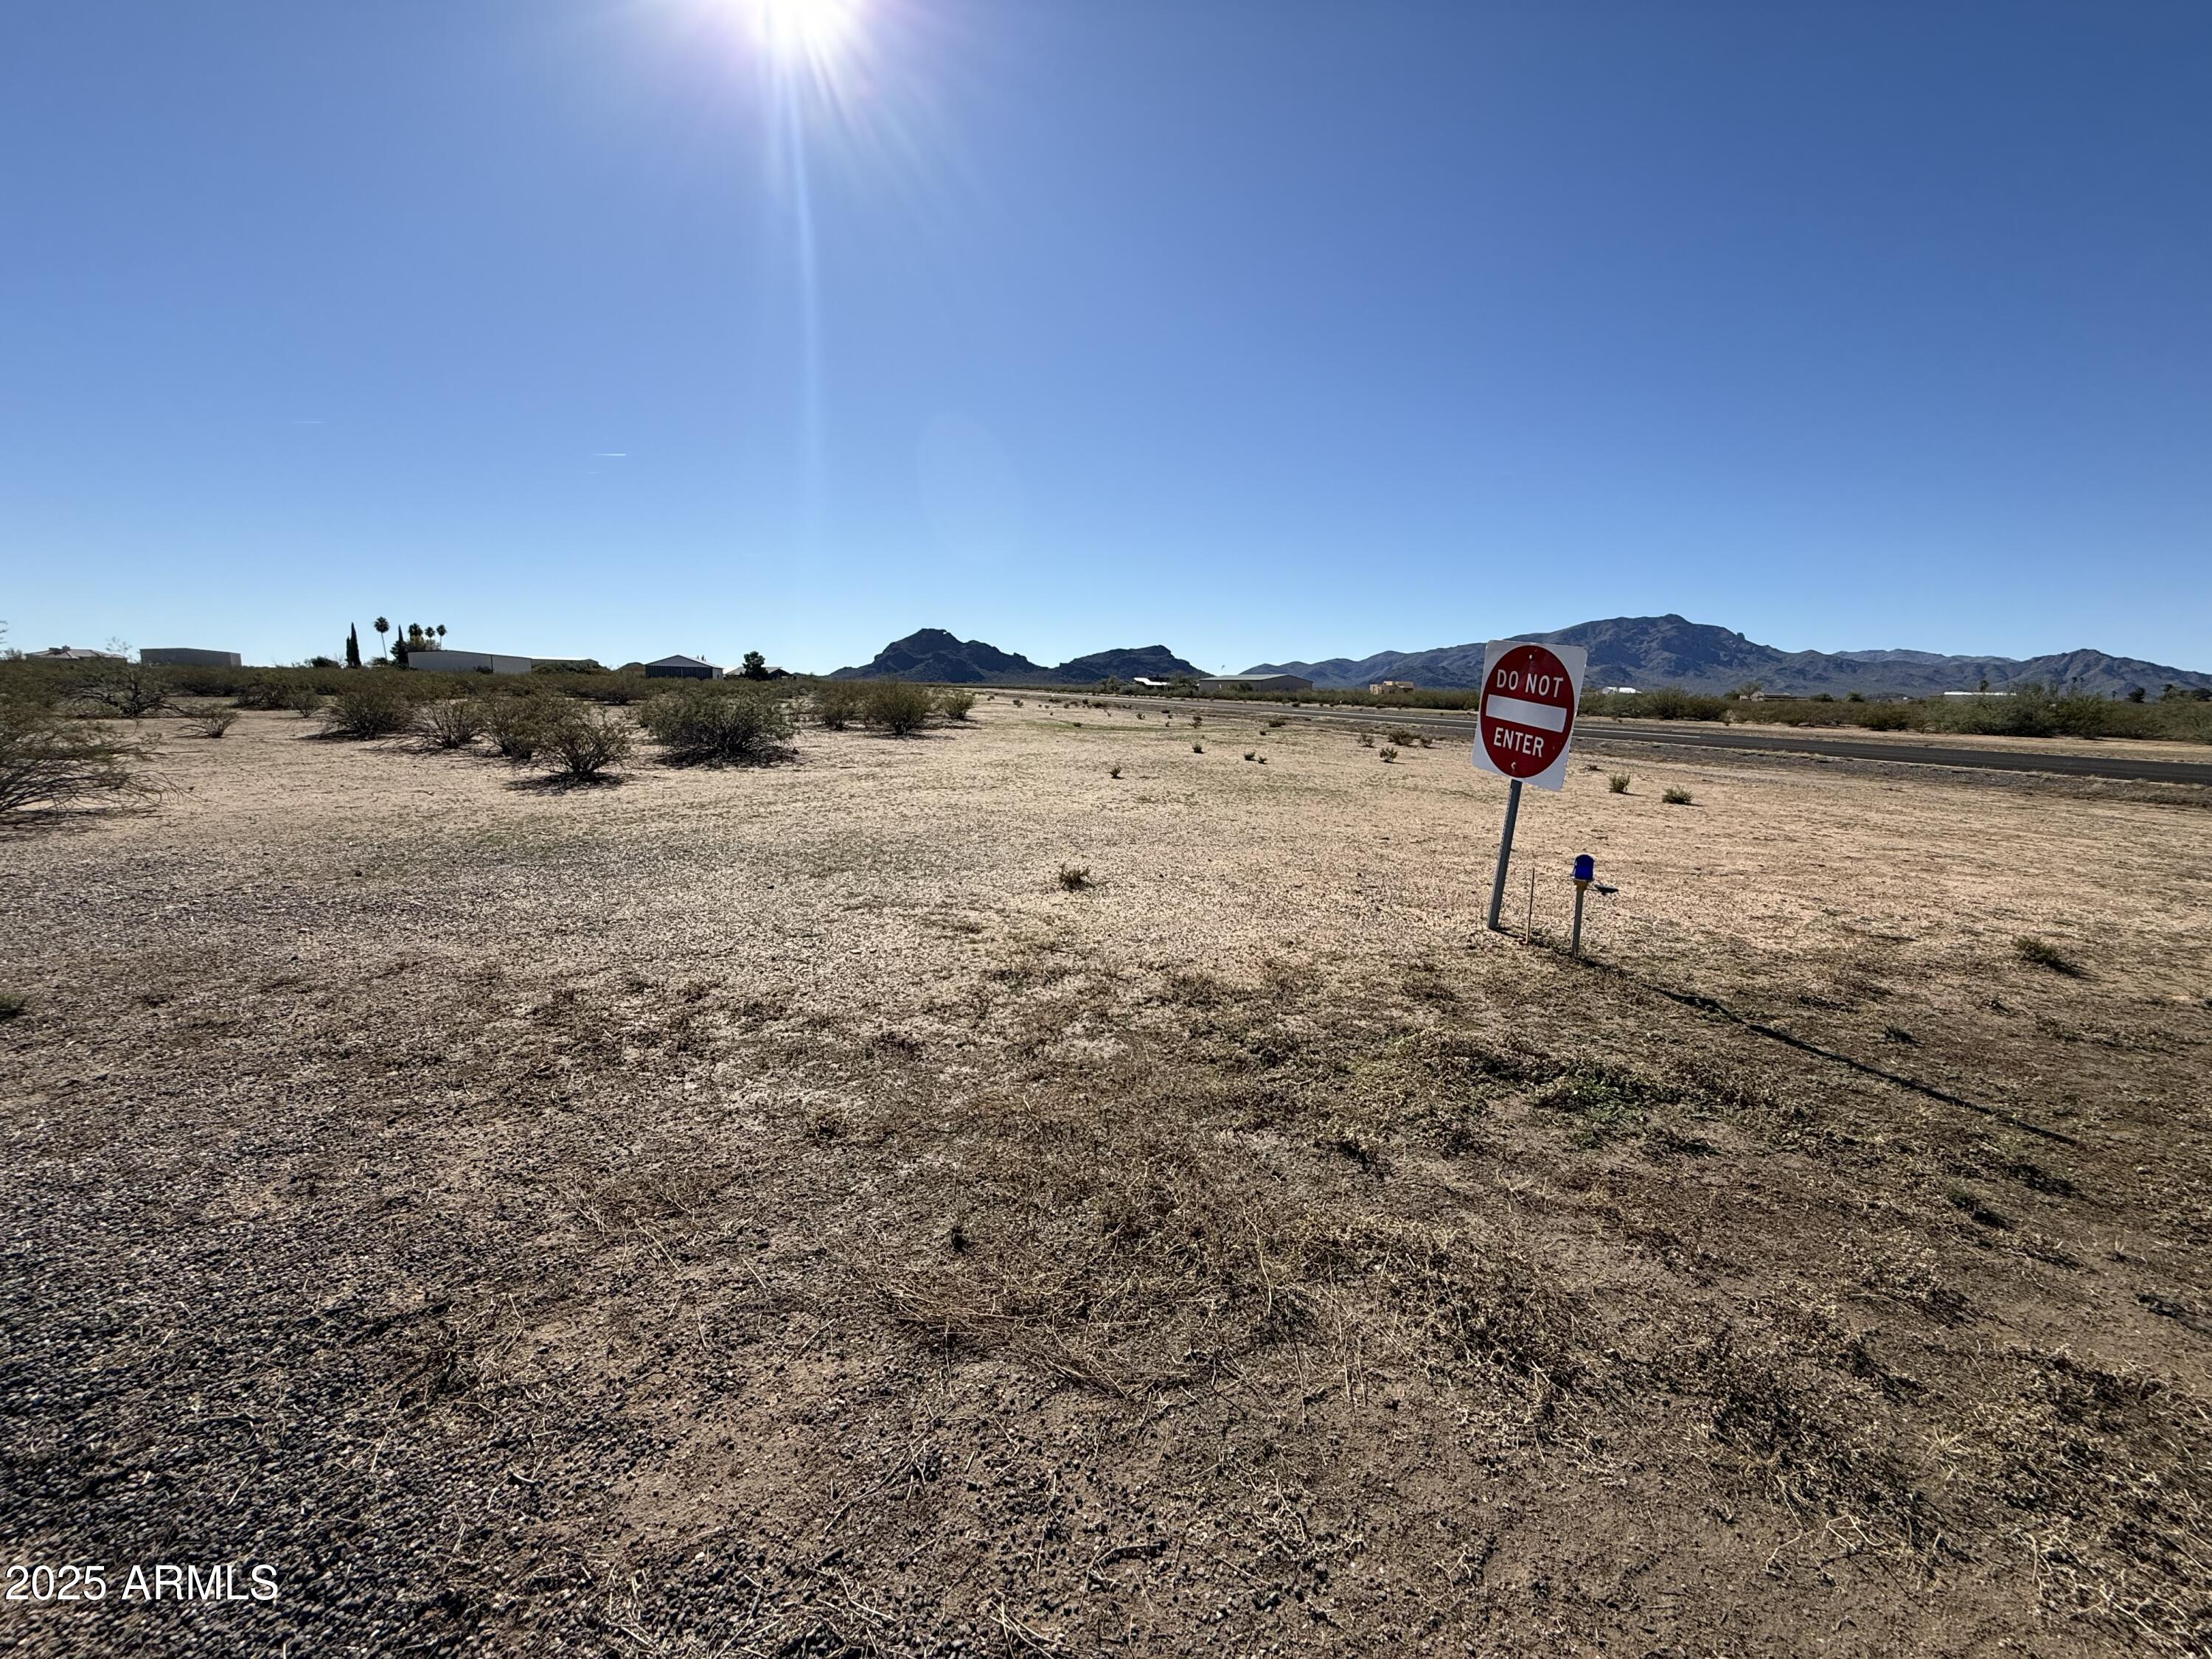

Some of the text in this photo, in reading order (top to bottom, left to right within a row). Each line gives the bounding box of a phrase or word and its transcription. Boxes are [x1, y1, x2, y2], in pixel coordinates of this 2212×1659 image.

[1496, 669, 1564, 698] DO NOT
[1493, 727, 1545, 757] ENTER
